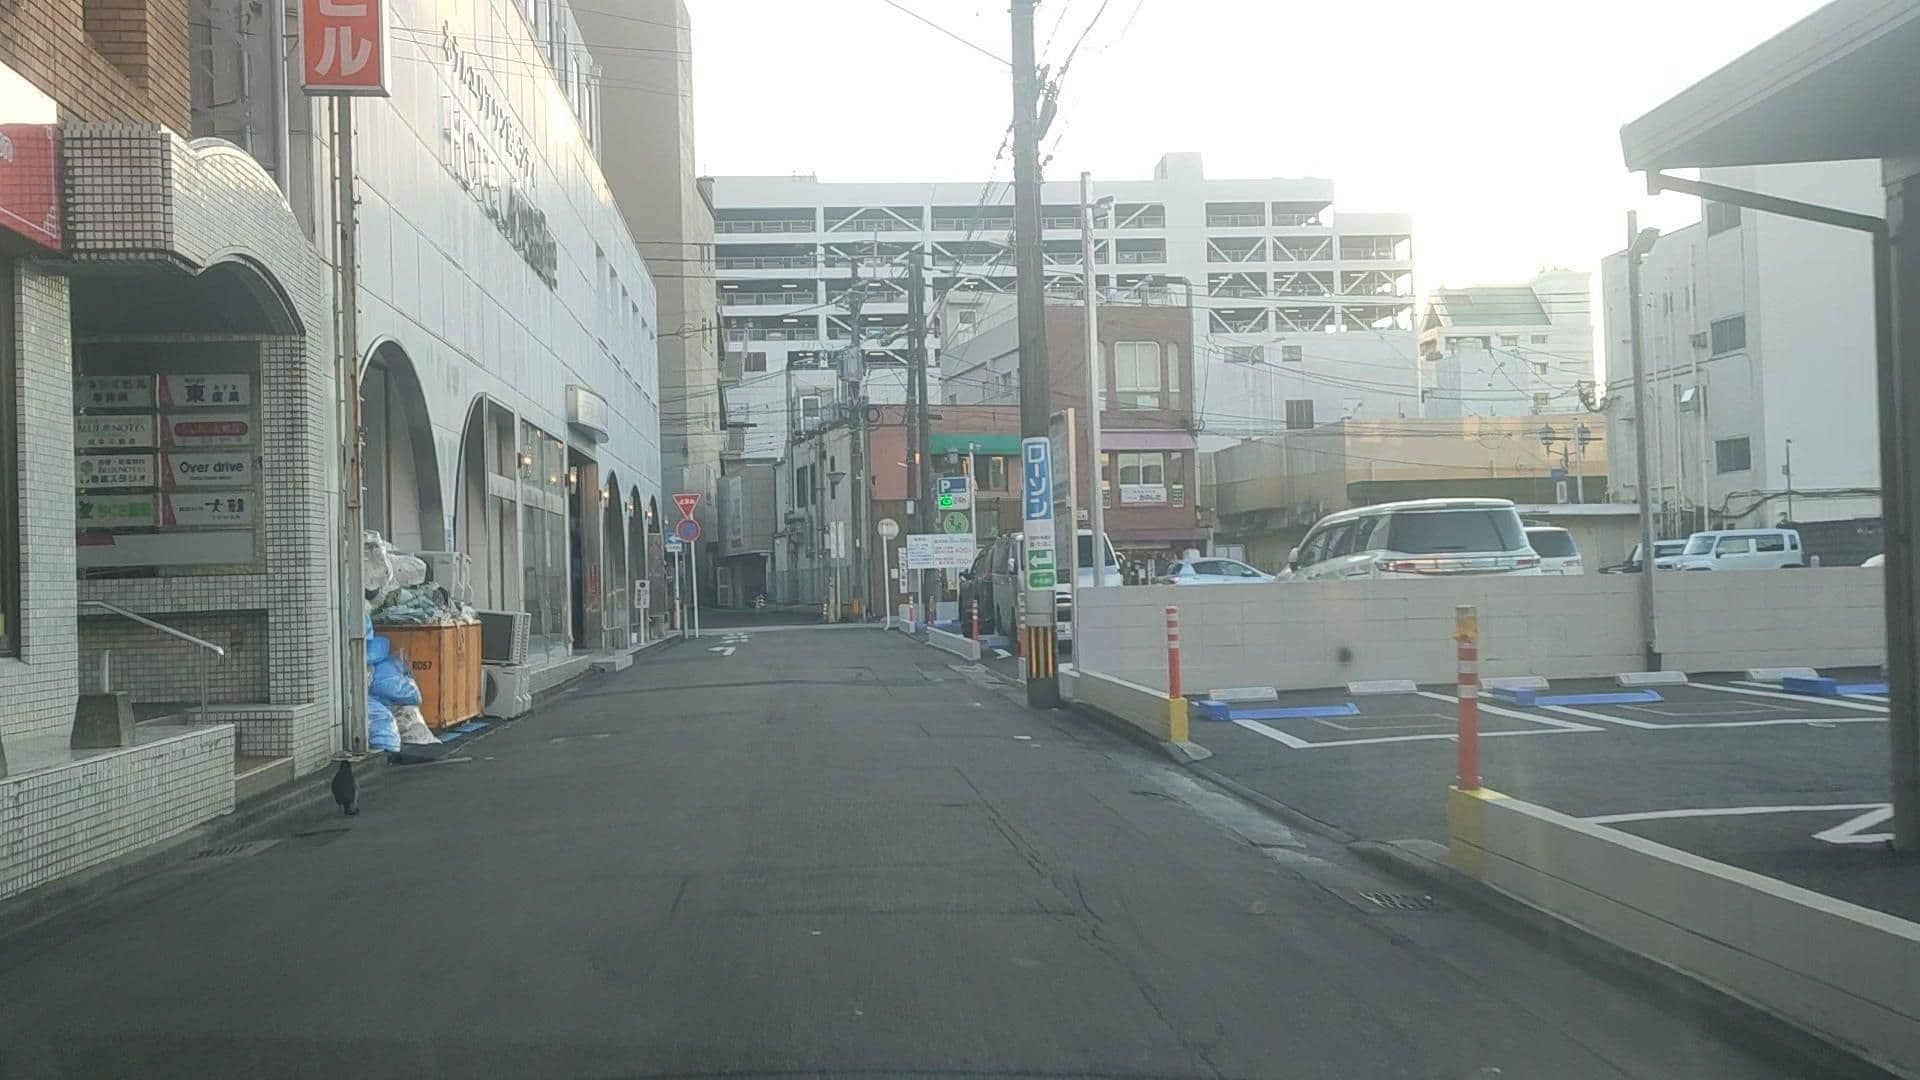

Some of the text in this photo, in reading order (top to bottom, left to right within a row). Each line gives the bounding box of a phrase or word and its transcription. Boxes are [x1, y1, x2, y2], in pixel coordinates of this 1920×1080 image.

[179, 461, 244, 474] Over drive
[940, 480, 951, 493] P
[1027, 443, 1049, 518] ローソン
